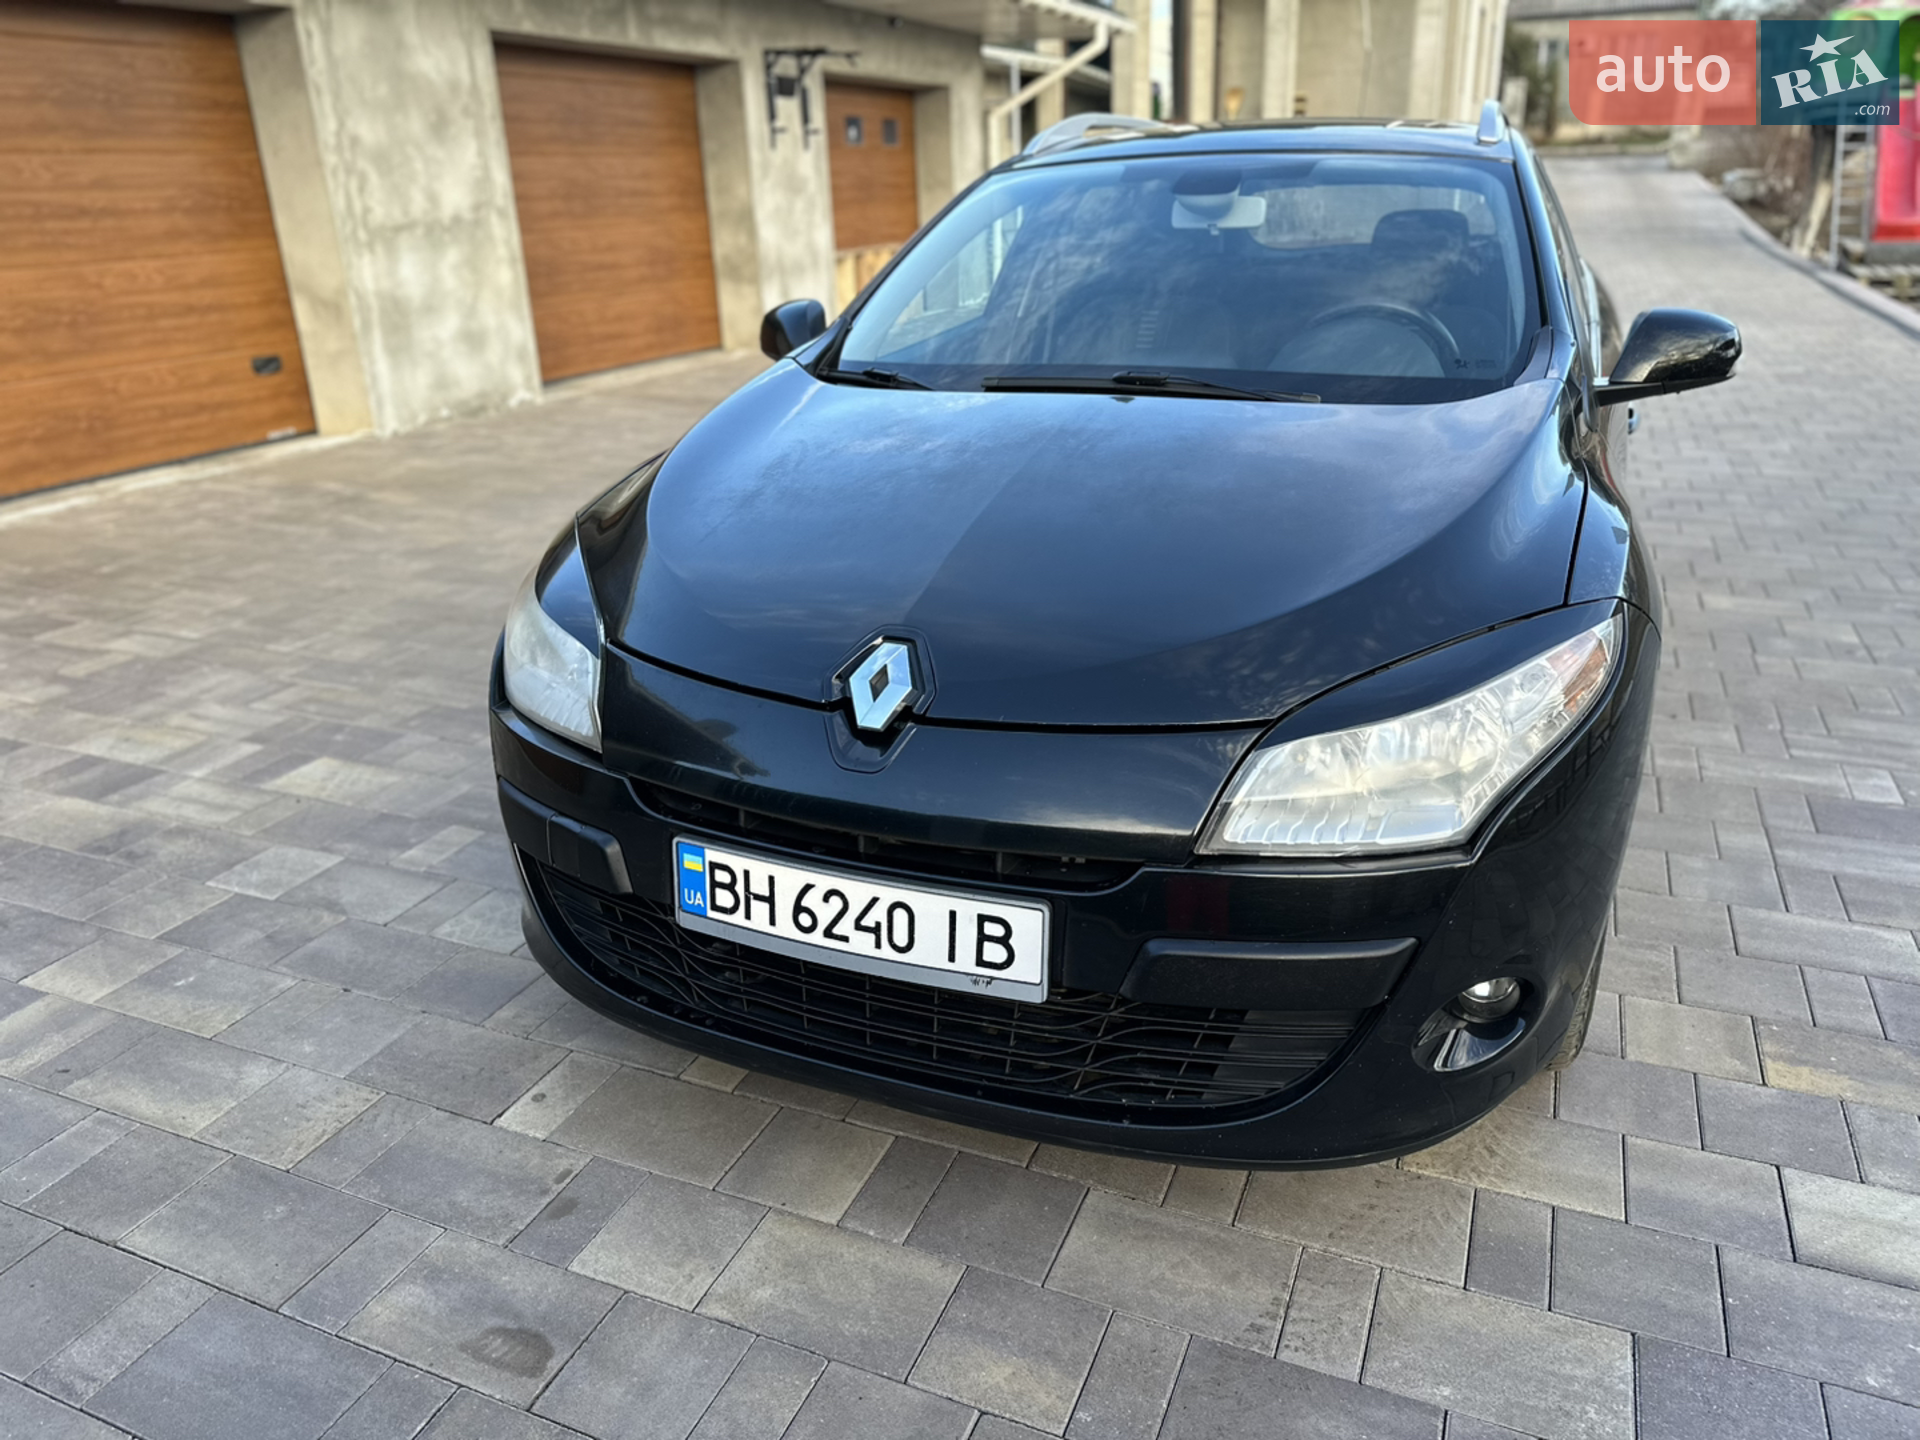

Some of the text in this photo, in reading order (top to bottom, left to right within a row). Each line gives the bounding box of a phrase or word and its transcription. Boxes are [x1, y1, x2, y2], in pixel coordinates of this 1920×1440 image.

[684, 887, 704, 907] UA
[708, 860, 1016, 971] BH 6240 IB
